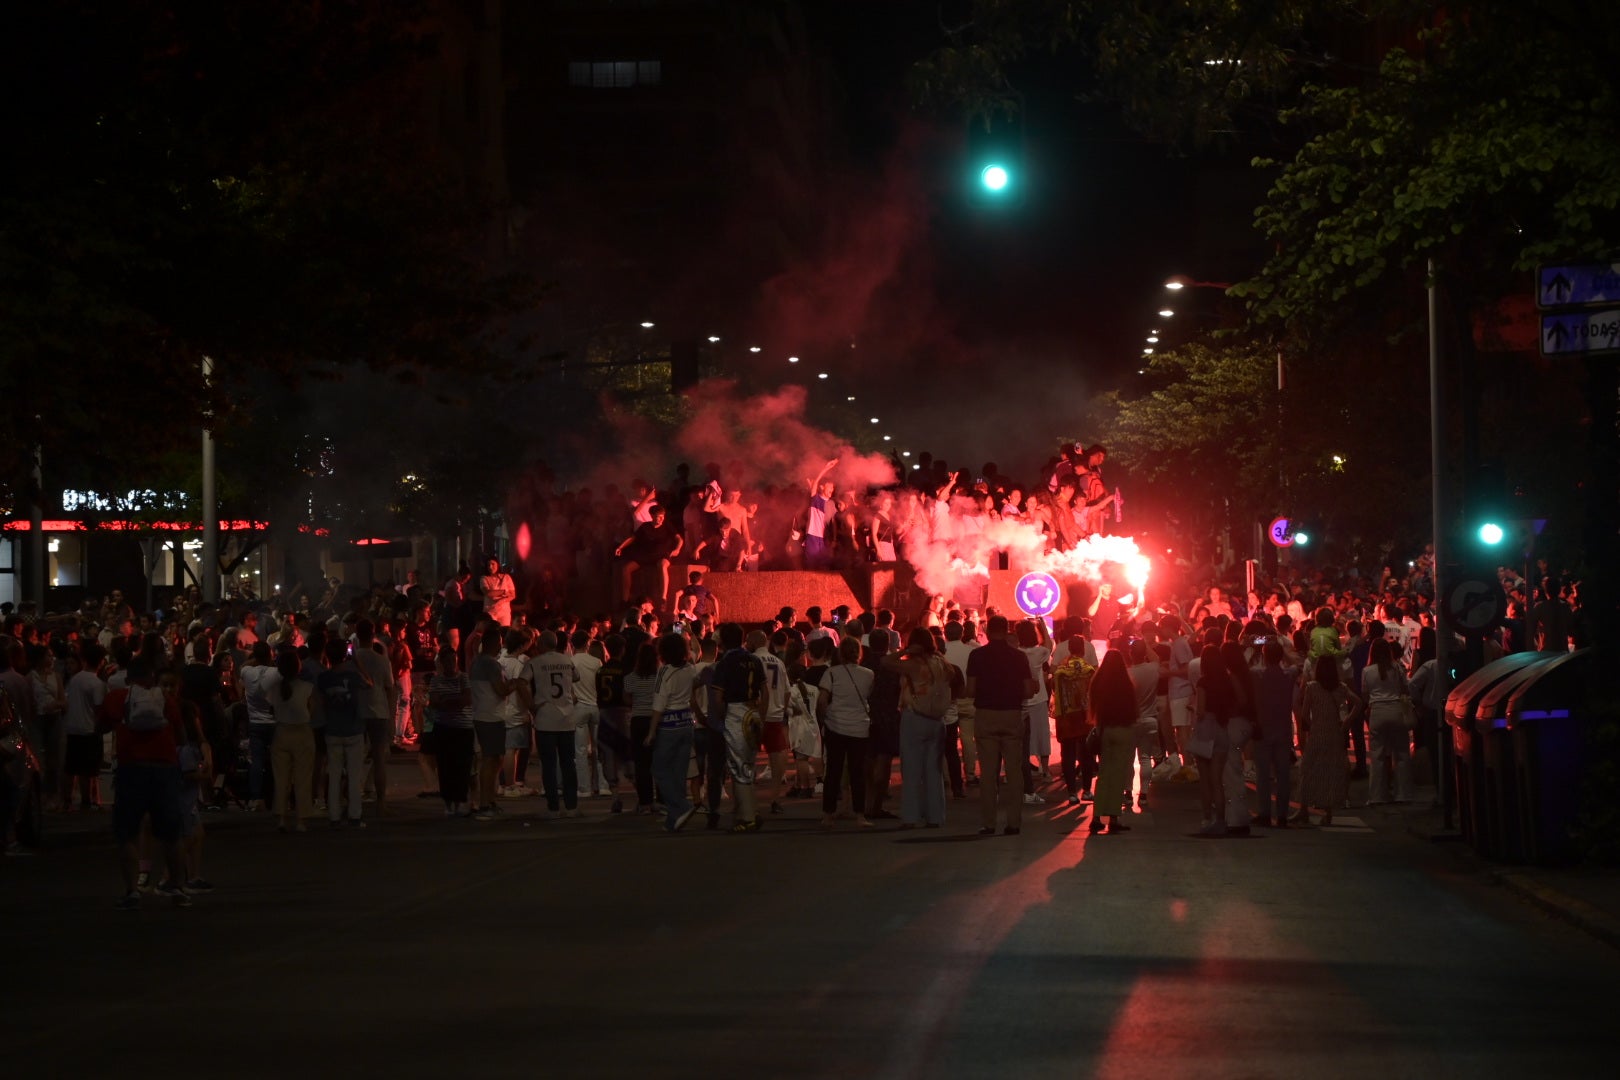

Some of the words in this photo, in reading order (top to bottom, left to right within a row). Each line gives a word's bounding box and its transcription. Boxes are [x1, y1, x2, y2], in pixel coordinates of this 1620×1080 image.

[1572, 323, 1617, 338] TODAS
[550, 672, 564, 699] 5
[767, 663, 779, 689] 7
